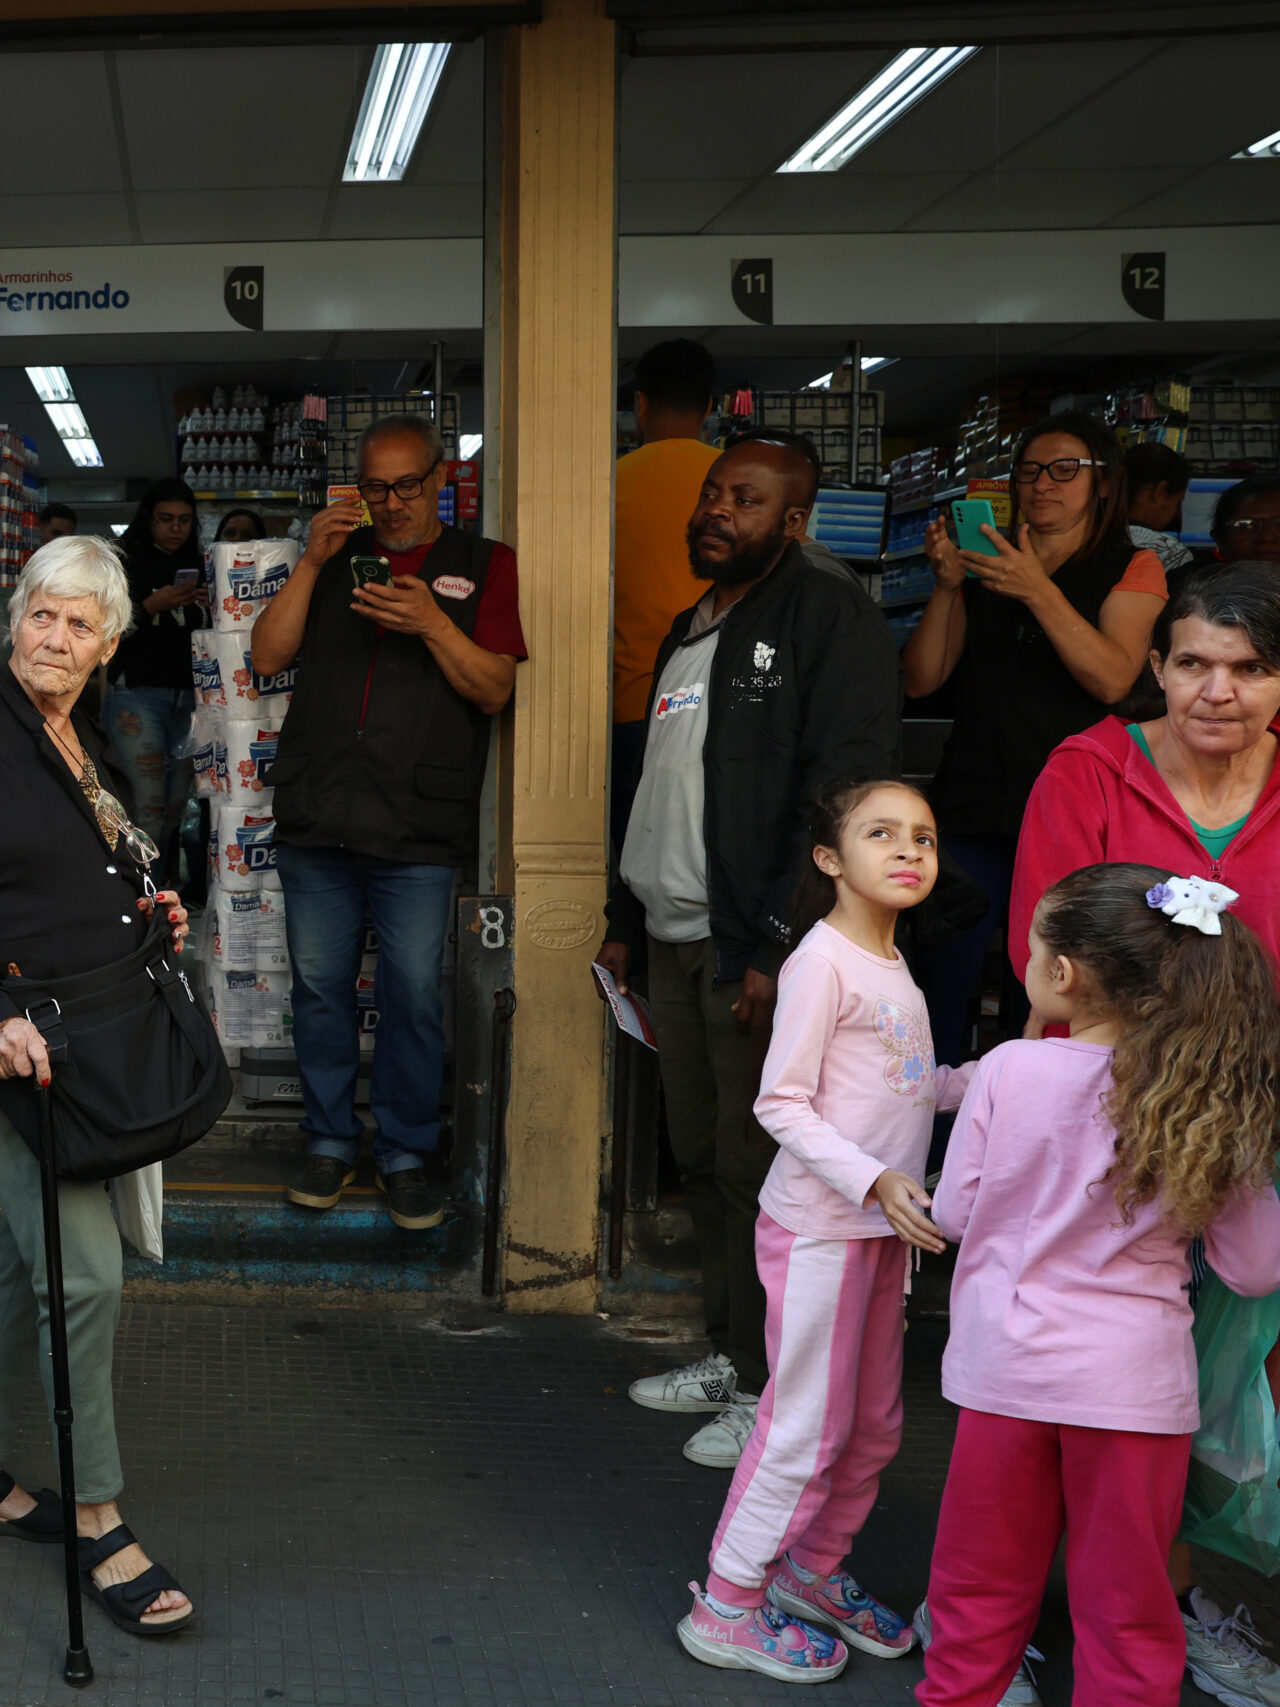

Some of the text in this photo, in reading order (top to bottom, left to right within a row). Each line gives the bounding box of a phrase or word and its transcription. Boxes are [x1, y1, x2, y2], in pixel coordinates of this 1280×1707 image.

[741, 272, 767, 295] 11
[1129, 266, 1160, 290] 12
[230, 279, 259, 302] 10
[479, 906, 505, 949] 8
[696, 1623, 735, 1644] Aloha!
